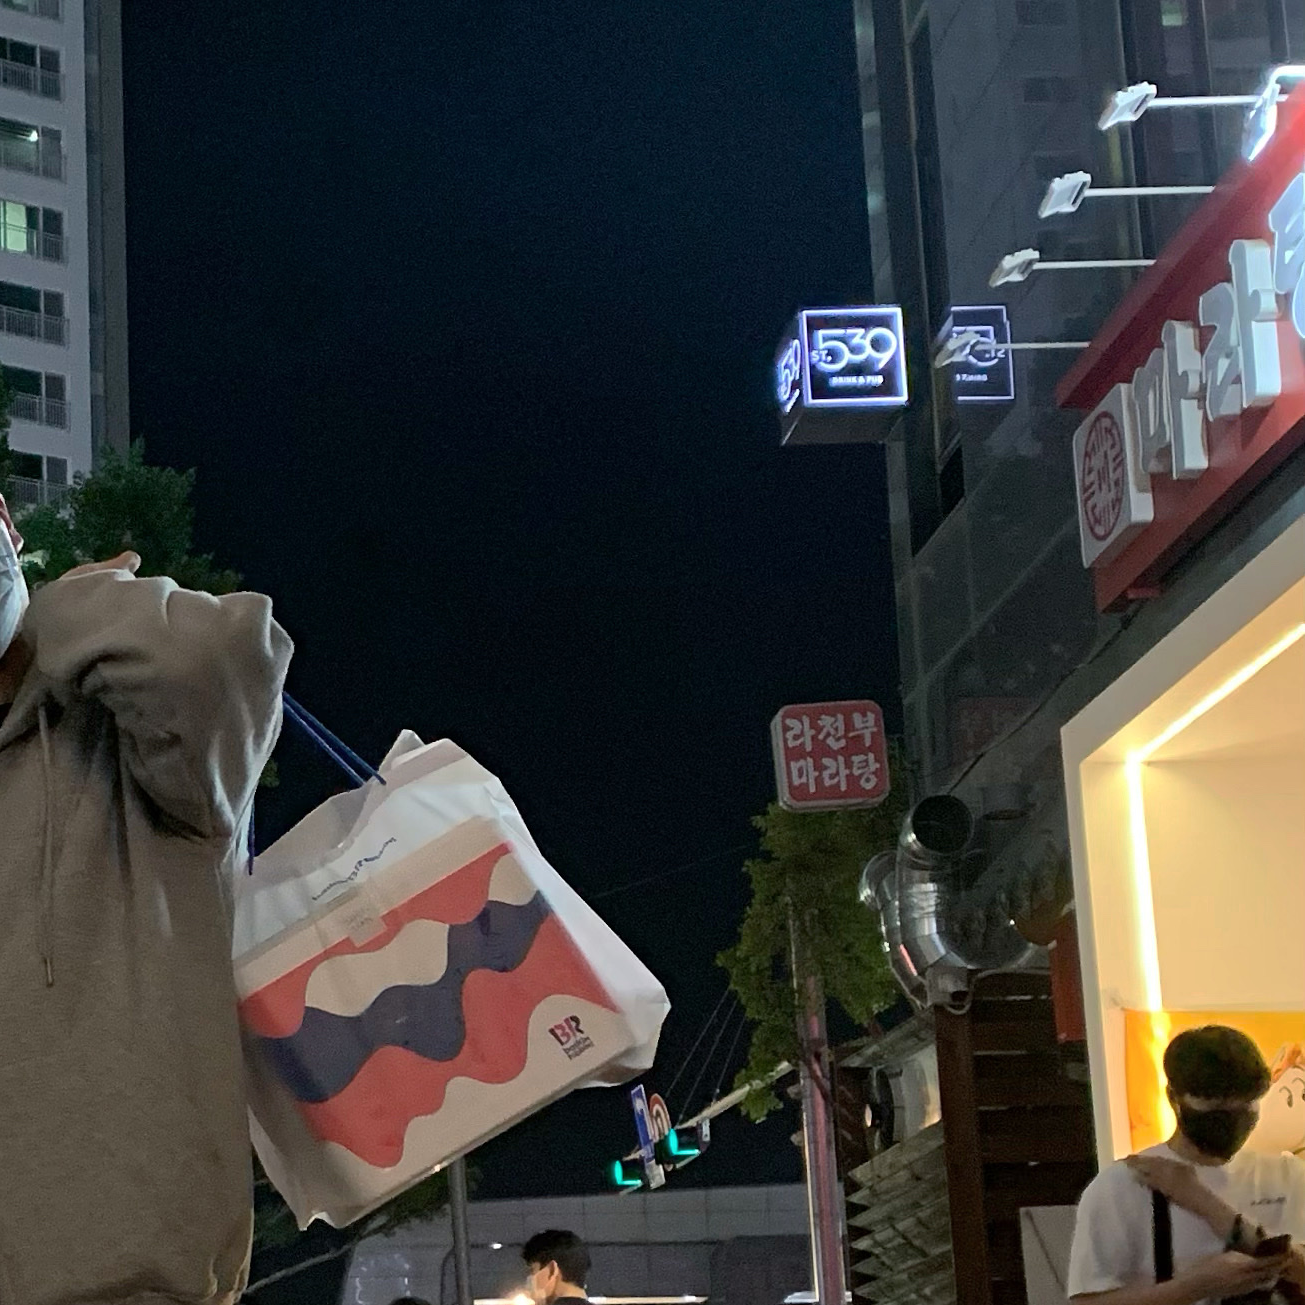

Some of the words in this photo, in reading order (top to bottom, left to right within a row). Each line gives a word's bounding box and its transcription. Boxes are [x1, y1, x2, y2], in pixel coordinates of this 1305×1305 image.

[1132, 172, 1305, 480] 마라
[814, 326, 898, 372] 539
[790, 752, 881, 792] 마라탕
[548, 1014, 584, 1046] BR
